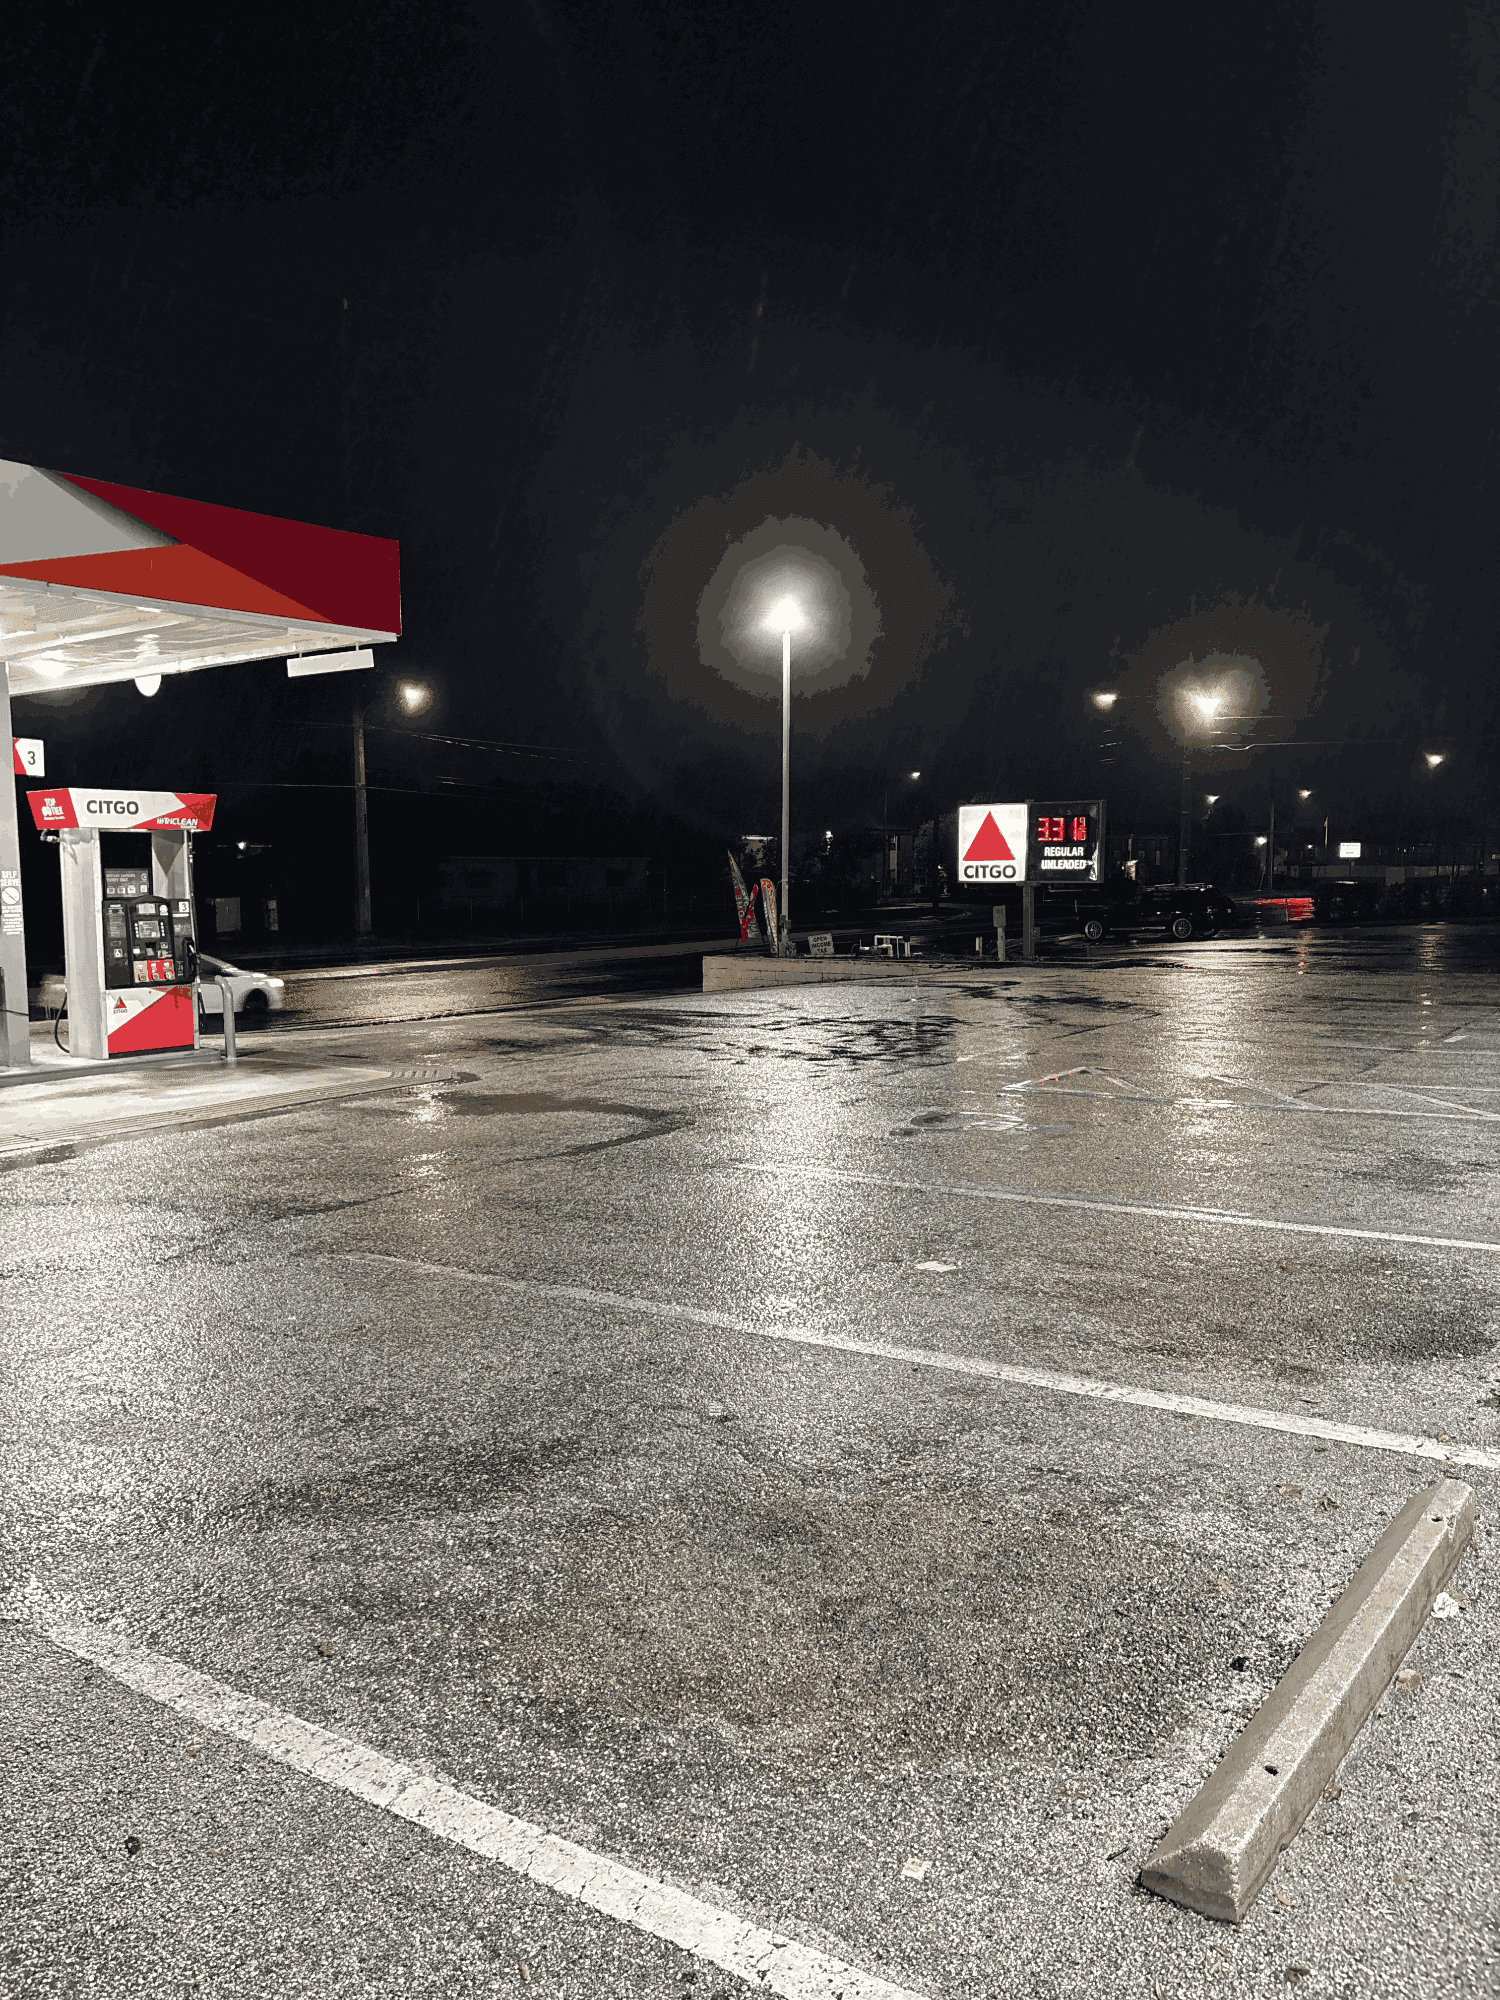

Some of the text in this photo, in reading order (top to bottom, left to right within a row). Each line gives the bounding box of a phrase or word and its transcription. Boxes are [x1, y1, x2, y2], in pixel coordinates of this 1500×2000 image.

[27, 751, 36, 765] 3
[86, 800, 139, 815] CITGO
[1044, 847, 1084, 857] REGULAR
[1041, 859, 1086, 869] UNLEADED
[964, 865, 1016, 879] CITGO
[181, 903, 187, 912] 3
[812, 940, 831, 948] INCOME
